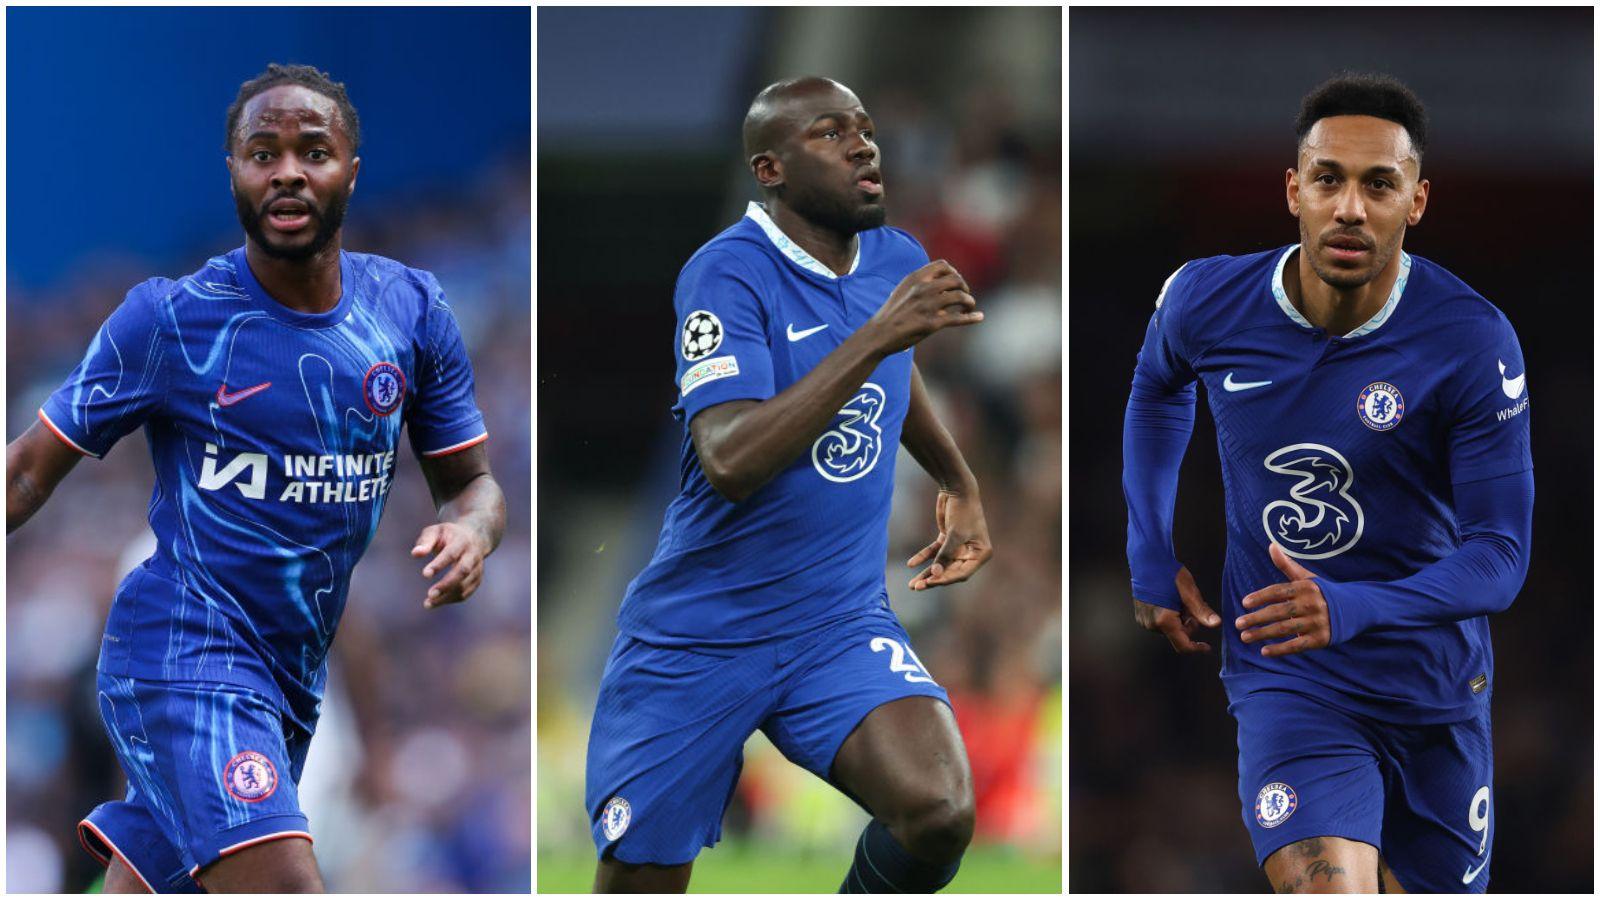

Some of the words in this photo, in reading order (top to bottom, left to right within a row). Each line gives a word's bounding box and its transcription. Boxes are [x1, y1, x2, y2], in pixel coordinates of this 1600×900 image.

[1369, 384, 1399, 399] CHELSEA
[284, 450, 394, 477] INFINITE
[1262, 443, 1364, 560] 3
[870, 637, 932, 678] 2
[1257, 784, 1287, 799] CHELSEA
[1468, 785, 1490, 857] 9
